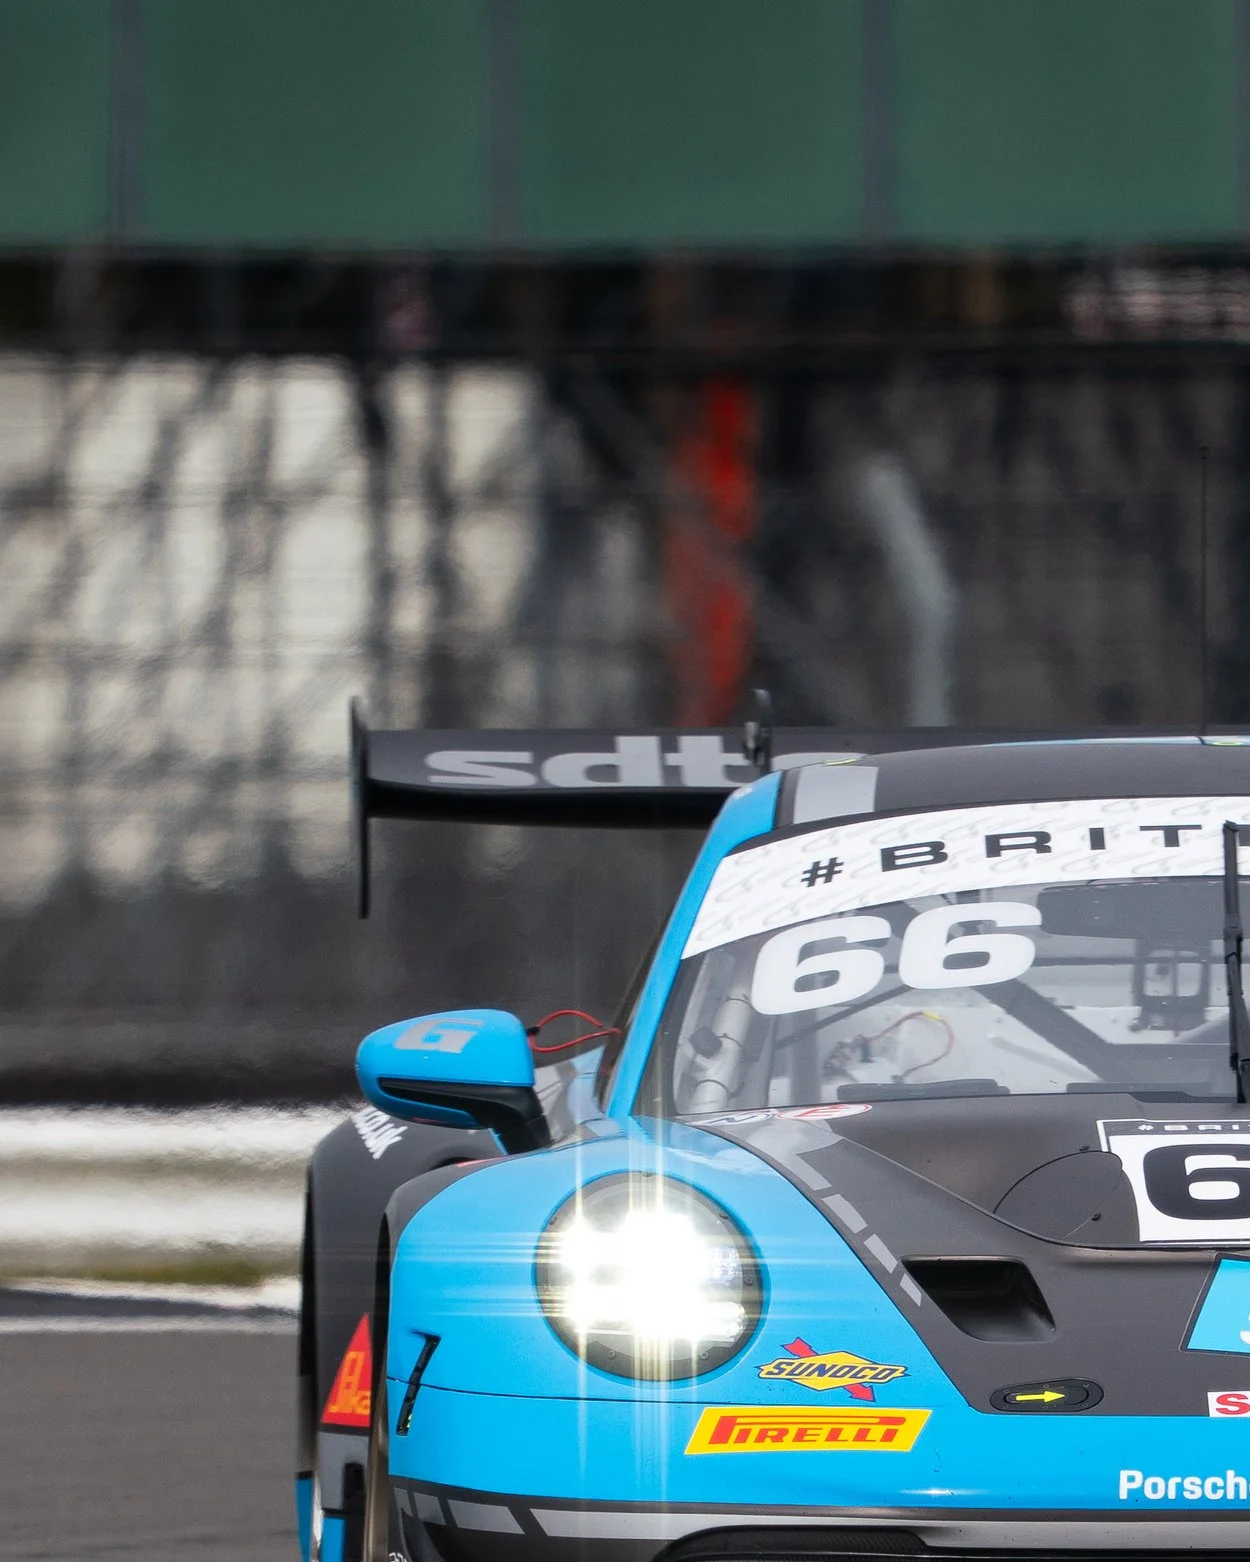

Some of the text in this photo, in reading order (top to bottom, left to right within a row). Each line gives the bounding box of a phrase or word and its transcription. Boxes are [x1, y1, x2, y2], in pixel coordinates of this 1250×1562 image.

[424, 735, 868, 788] sdt
[750, 901, 1042, 1015] 66
[393, 1018, 485, 1054] G
[767, 1361, 900, 1381] SUNOCO
[708, 1415, 906, 1444] PIRELLI
